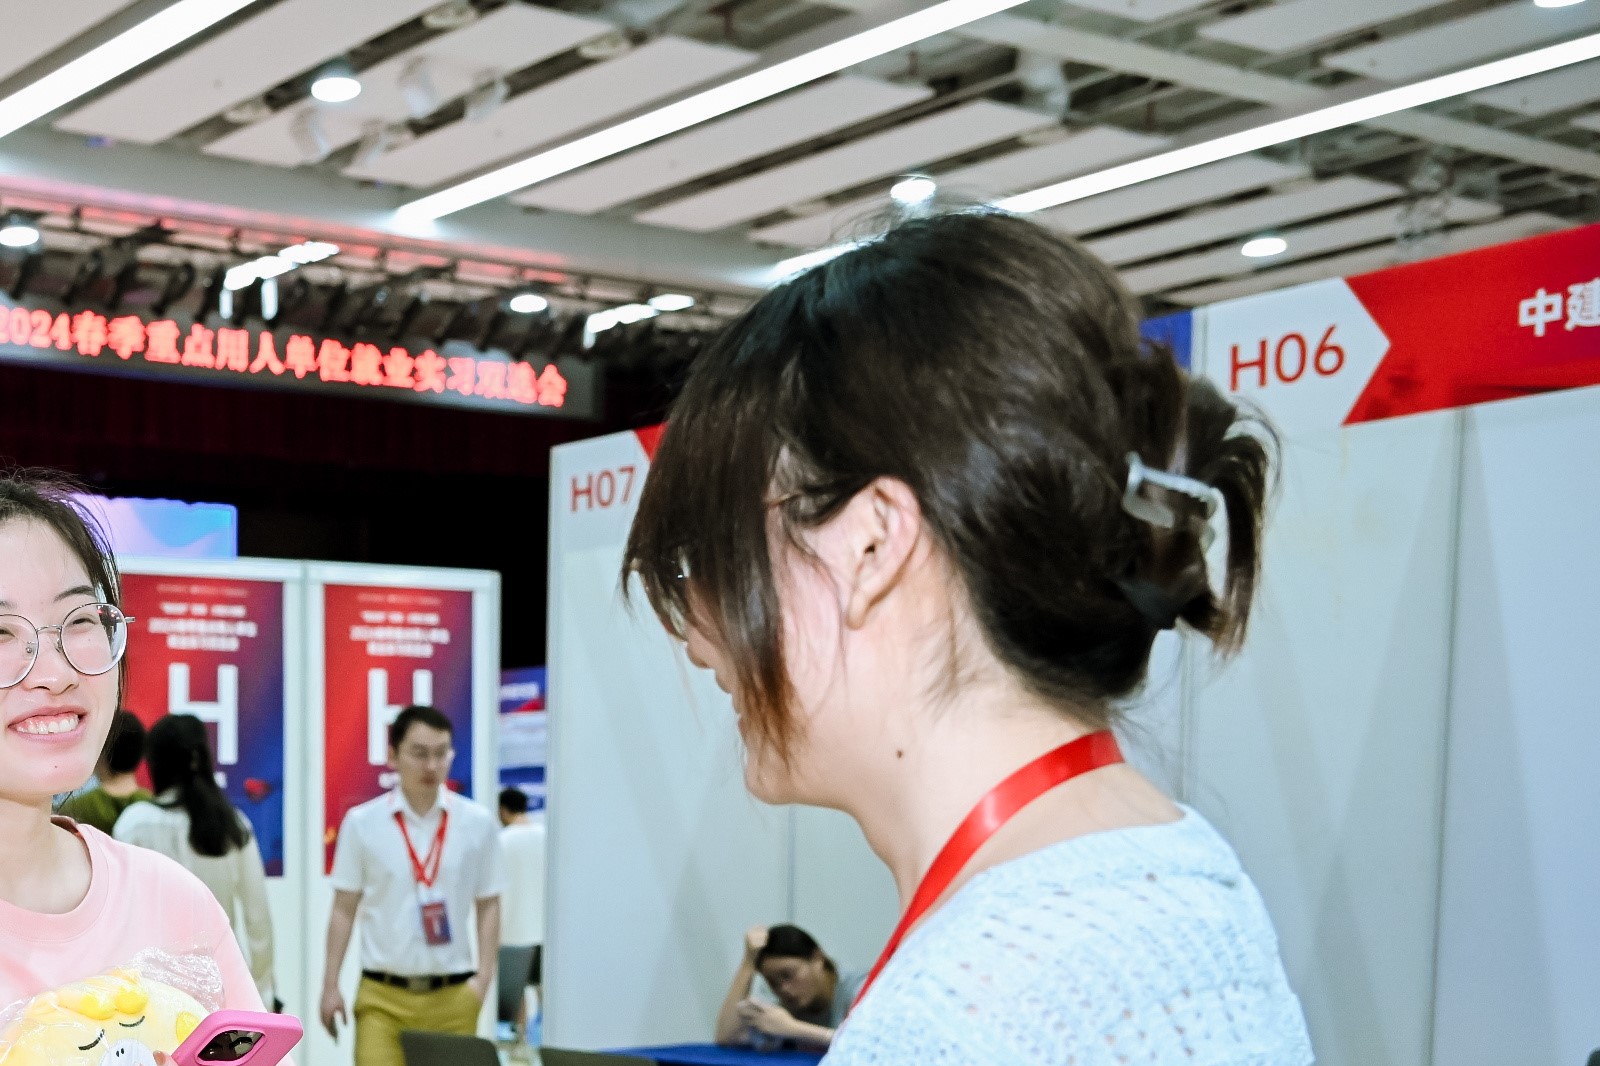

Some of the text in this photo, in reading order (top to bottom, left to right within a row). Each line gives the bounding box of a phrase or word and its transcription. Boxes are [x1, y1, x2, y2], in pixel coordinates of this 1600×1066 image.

[1229, 323, 1346, 393] H06
[570, 464, 634, 513] H07
[167, 662, 239, 765] H
